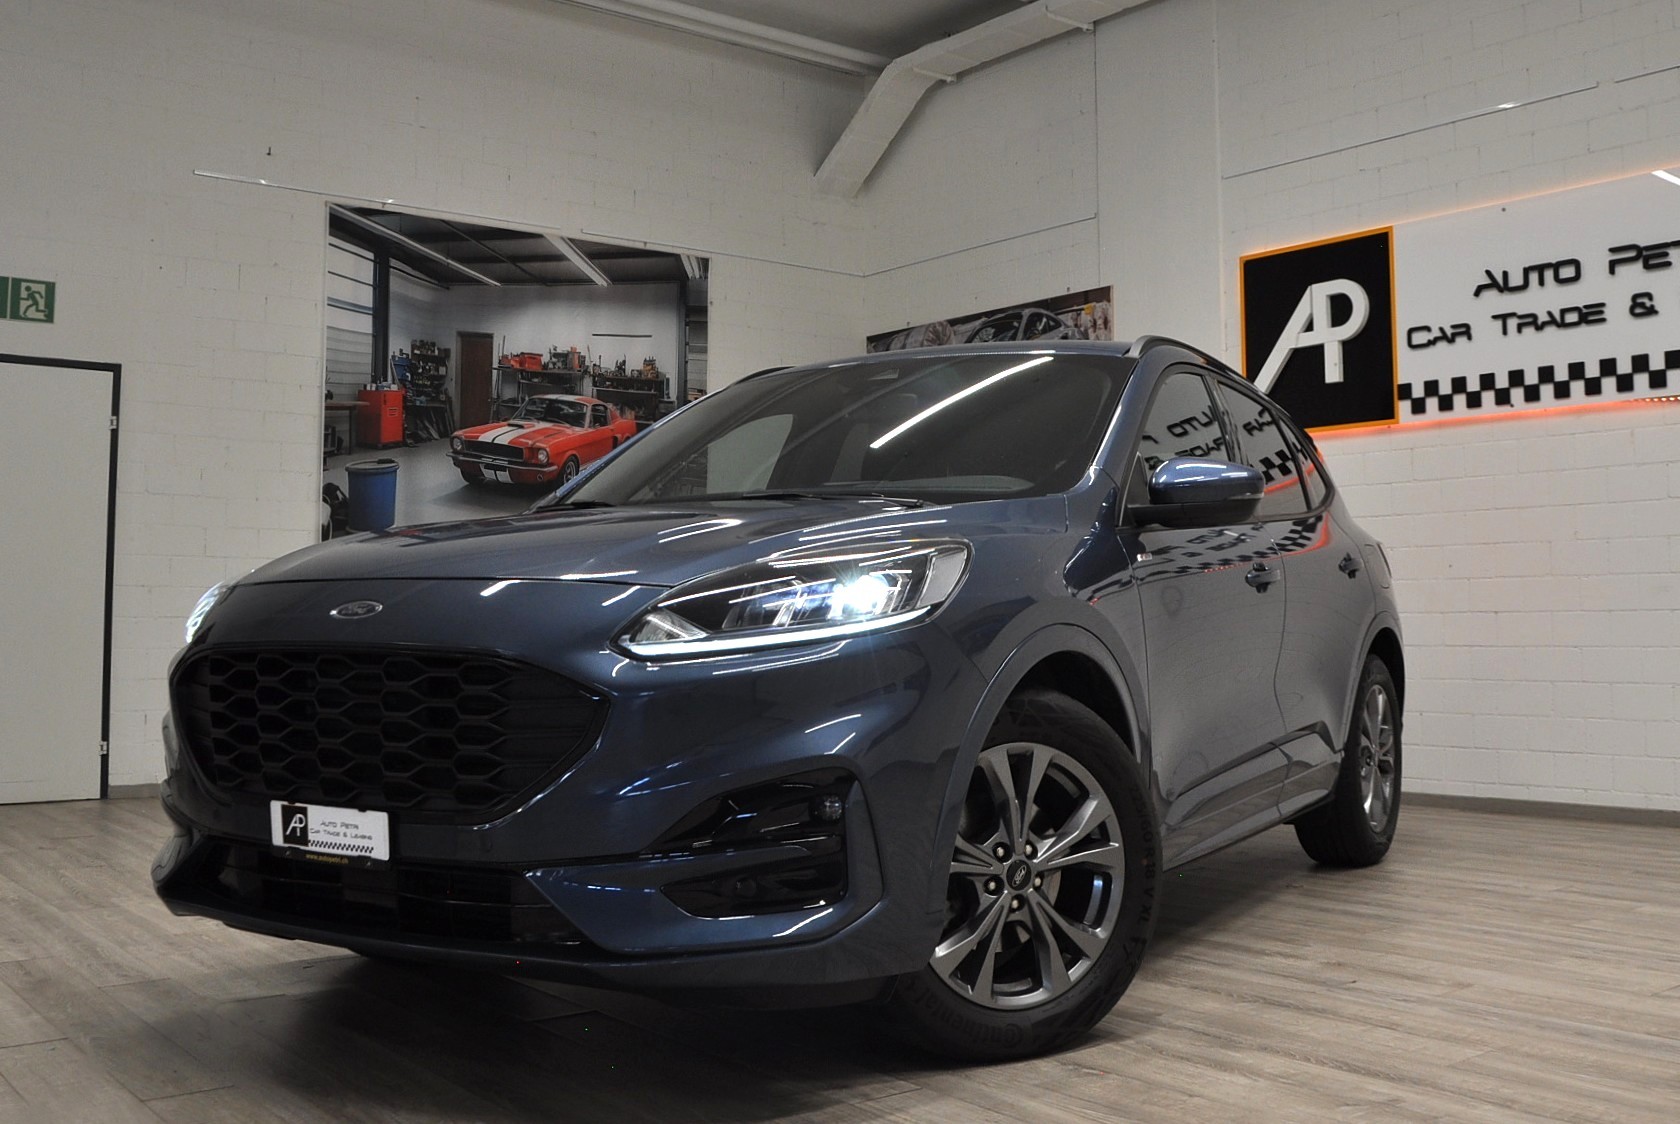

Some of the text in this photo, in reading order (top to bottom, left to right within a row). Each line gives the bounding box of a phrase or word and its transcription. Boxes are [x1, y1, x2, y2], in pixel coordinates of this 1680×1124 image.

[1473, 258, 1581, 297] AUTO
[1407, 291, 1659, 349] CAR TRADE &
[320, 820, 337, 829] AUTO
